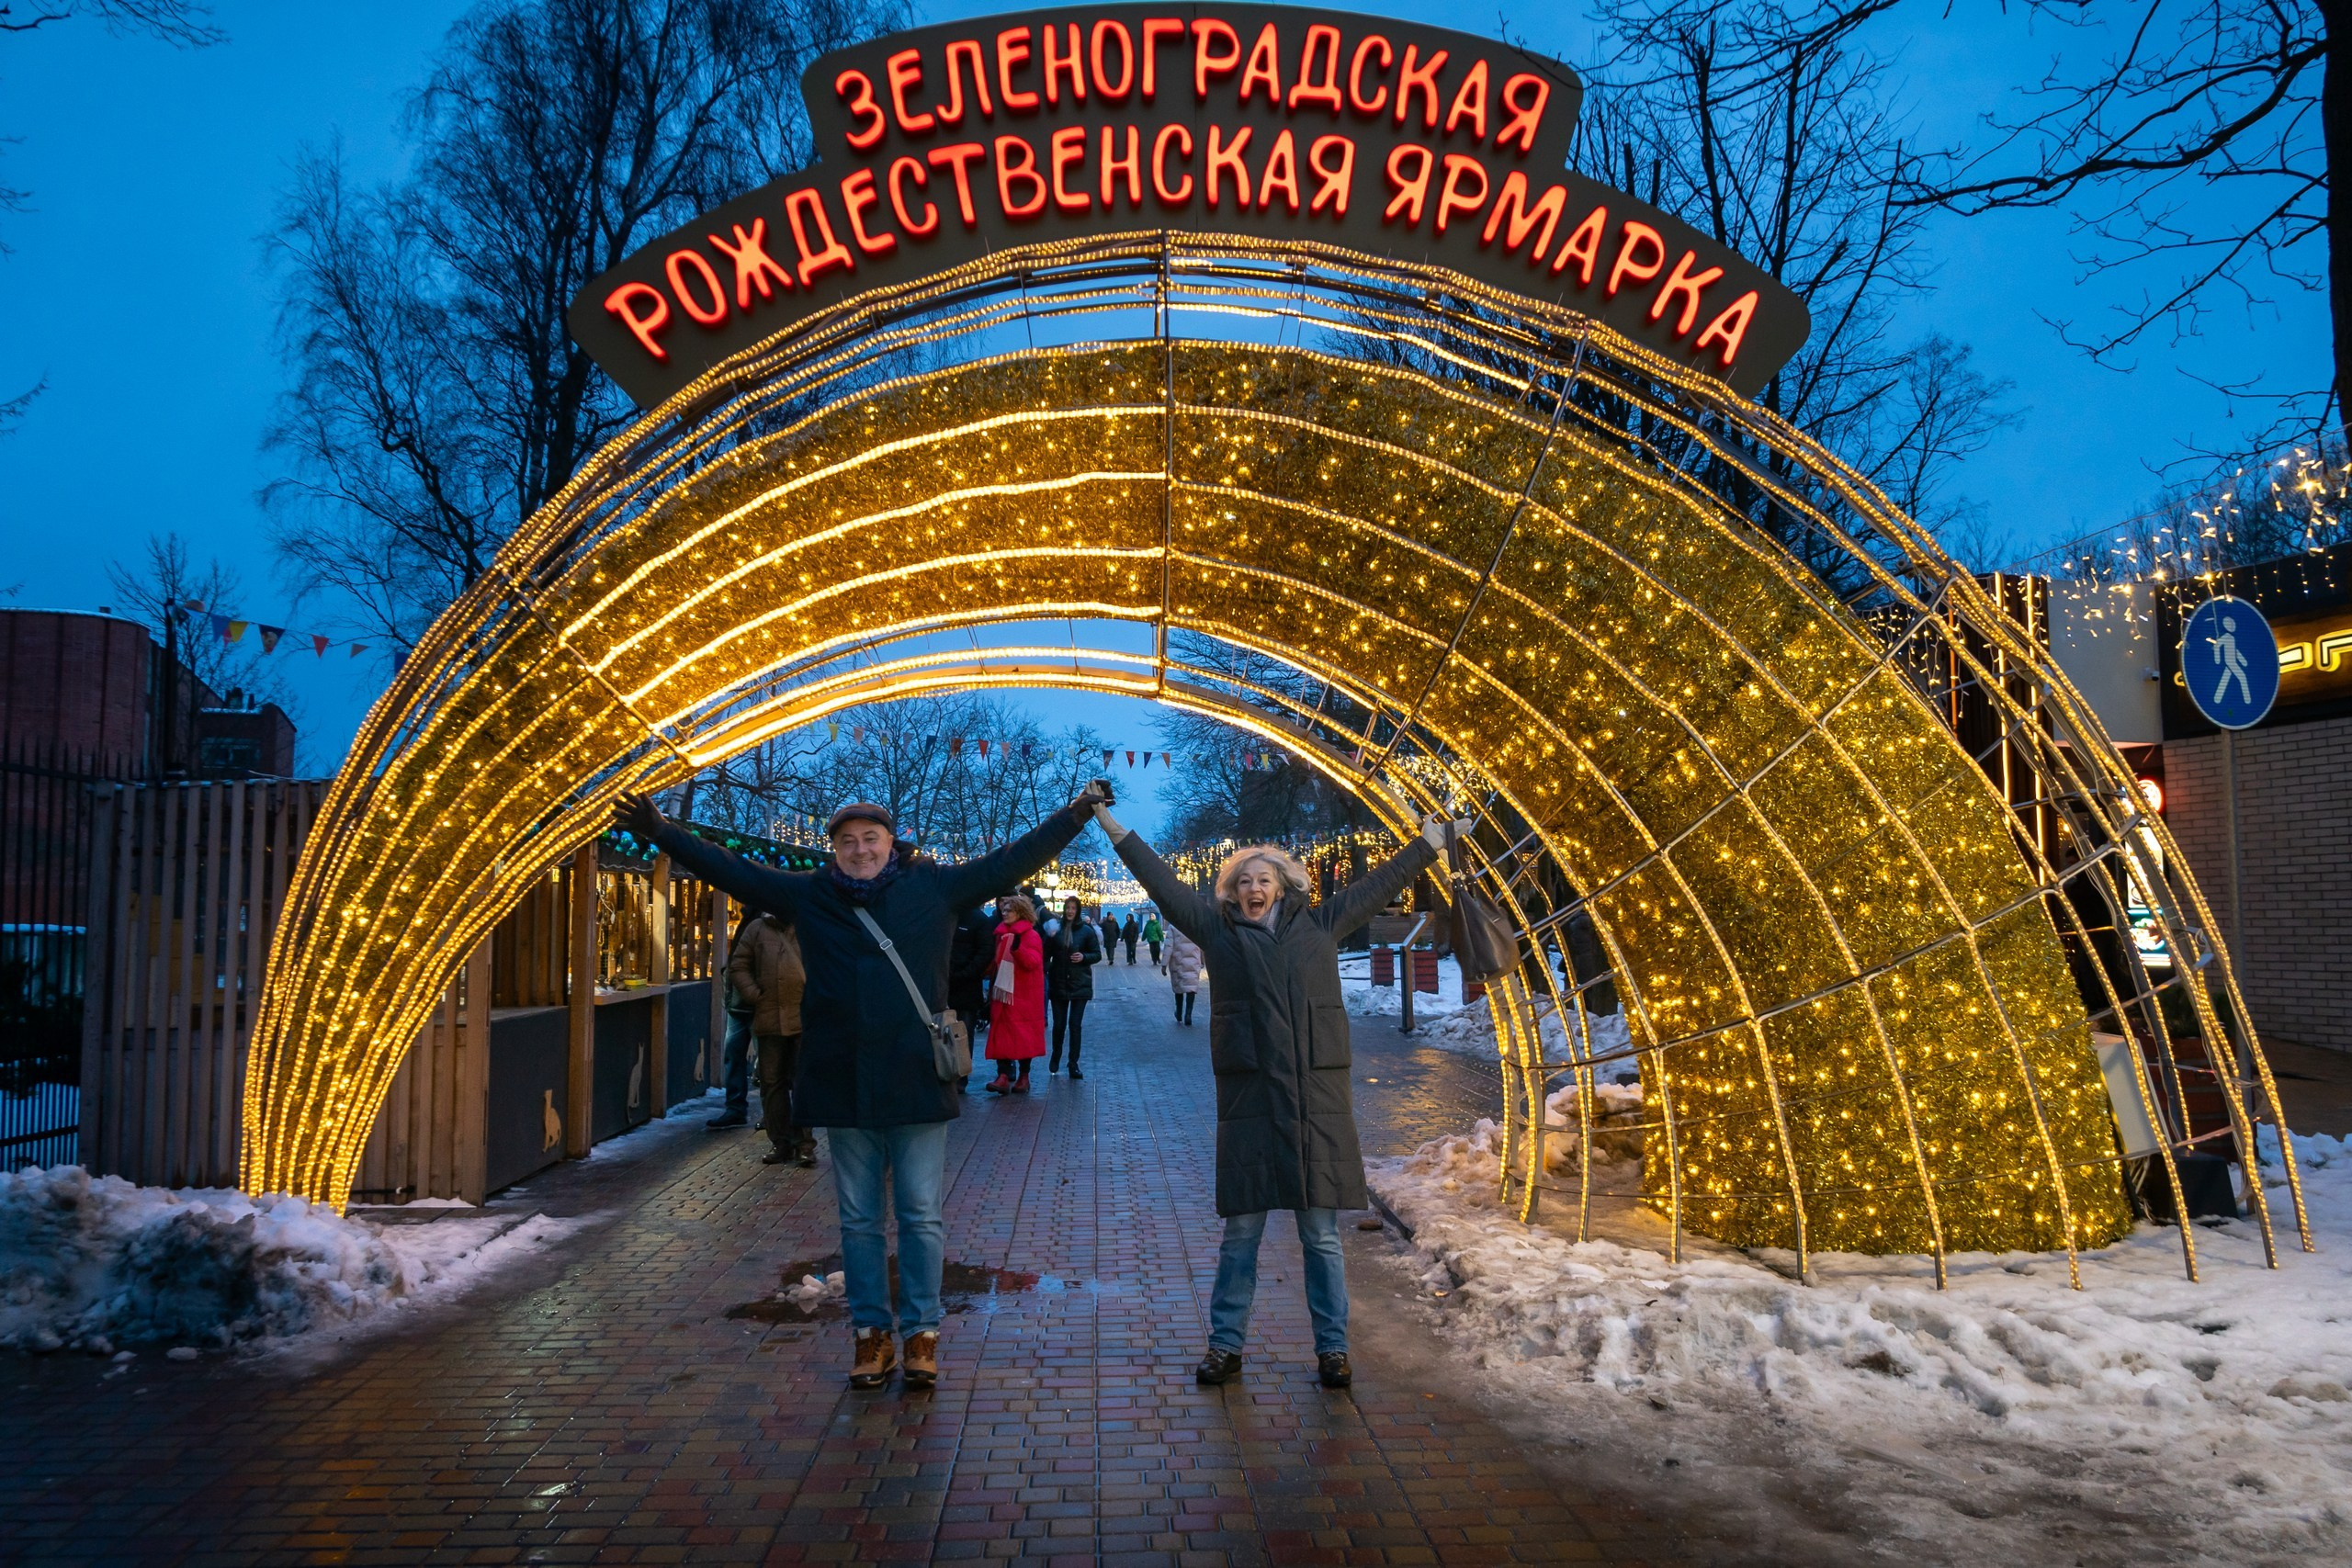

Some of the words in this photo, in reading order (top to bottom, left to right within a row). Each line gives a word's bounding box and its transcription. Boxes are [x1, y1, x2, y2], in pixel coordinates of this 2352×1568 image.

[833, 17, 1551, 152] ЗЕЛЕНОГРАДСКАЯ
[603, 122, 1357, 358] РОЖДЕСТВЕНСКАЯ
[1384, 142, 1760, 366] ЯРМАРКА
